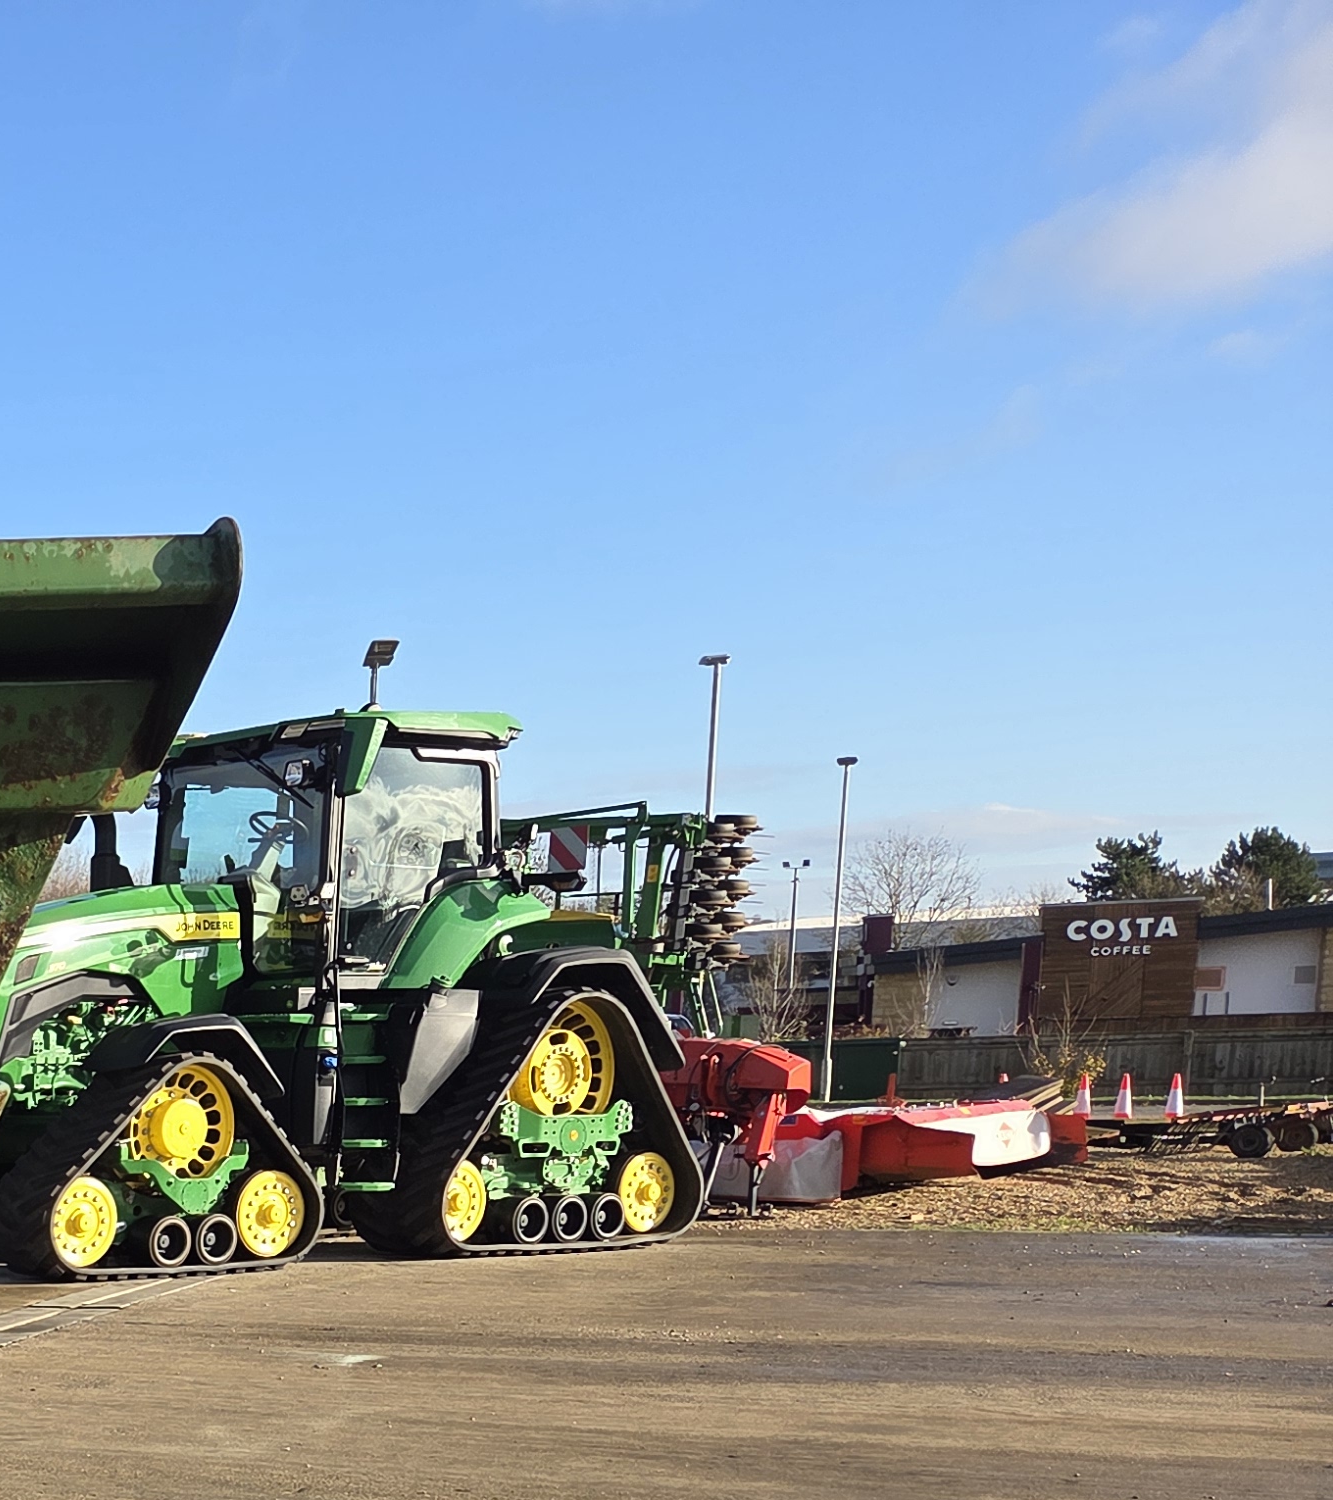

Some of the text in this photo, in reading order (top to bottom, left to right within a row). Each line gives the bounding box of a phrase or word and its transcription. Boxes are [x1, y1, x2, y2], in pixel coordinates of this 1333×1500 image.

[176, 919, 234, 932] JOHN DEERE
[1066, 916, 1178, 942] COSTA
[1090, 945, 1151, 956] COFFEE
